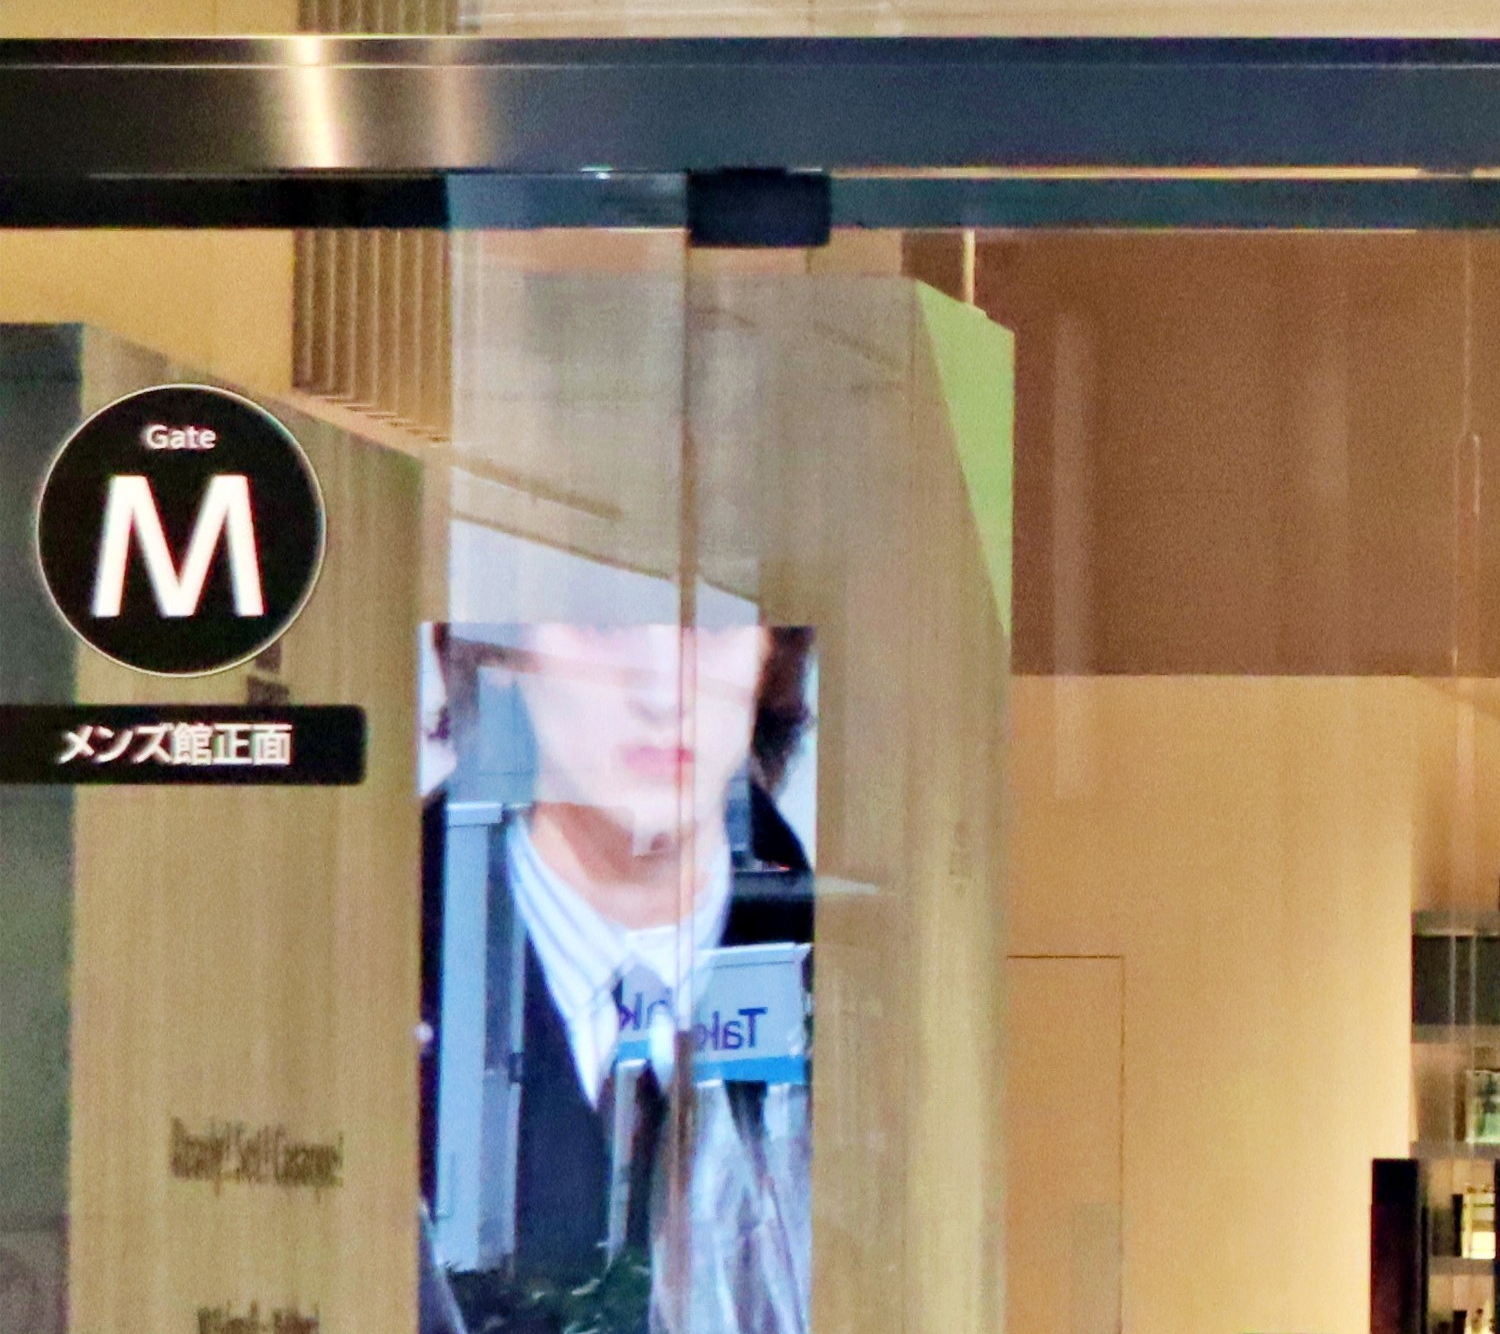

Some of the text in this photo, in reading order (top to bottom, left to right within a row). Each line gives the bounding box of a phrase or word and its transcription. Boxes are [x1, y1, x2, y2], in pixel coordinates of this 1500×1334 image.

[143, 424, 216, 451] Gate
[92, 475, 265, 617] M
[59, 722, 292, 766] メンズ館正面
